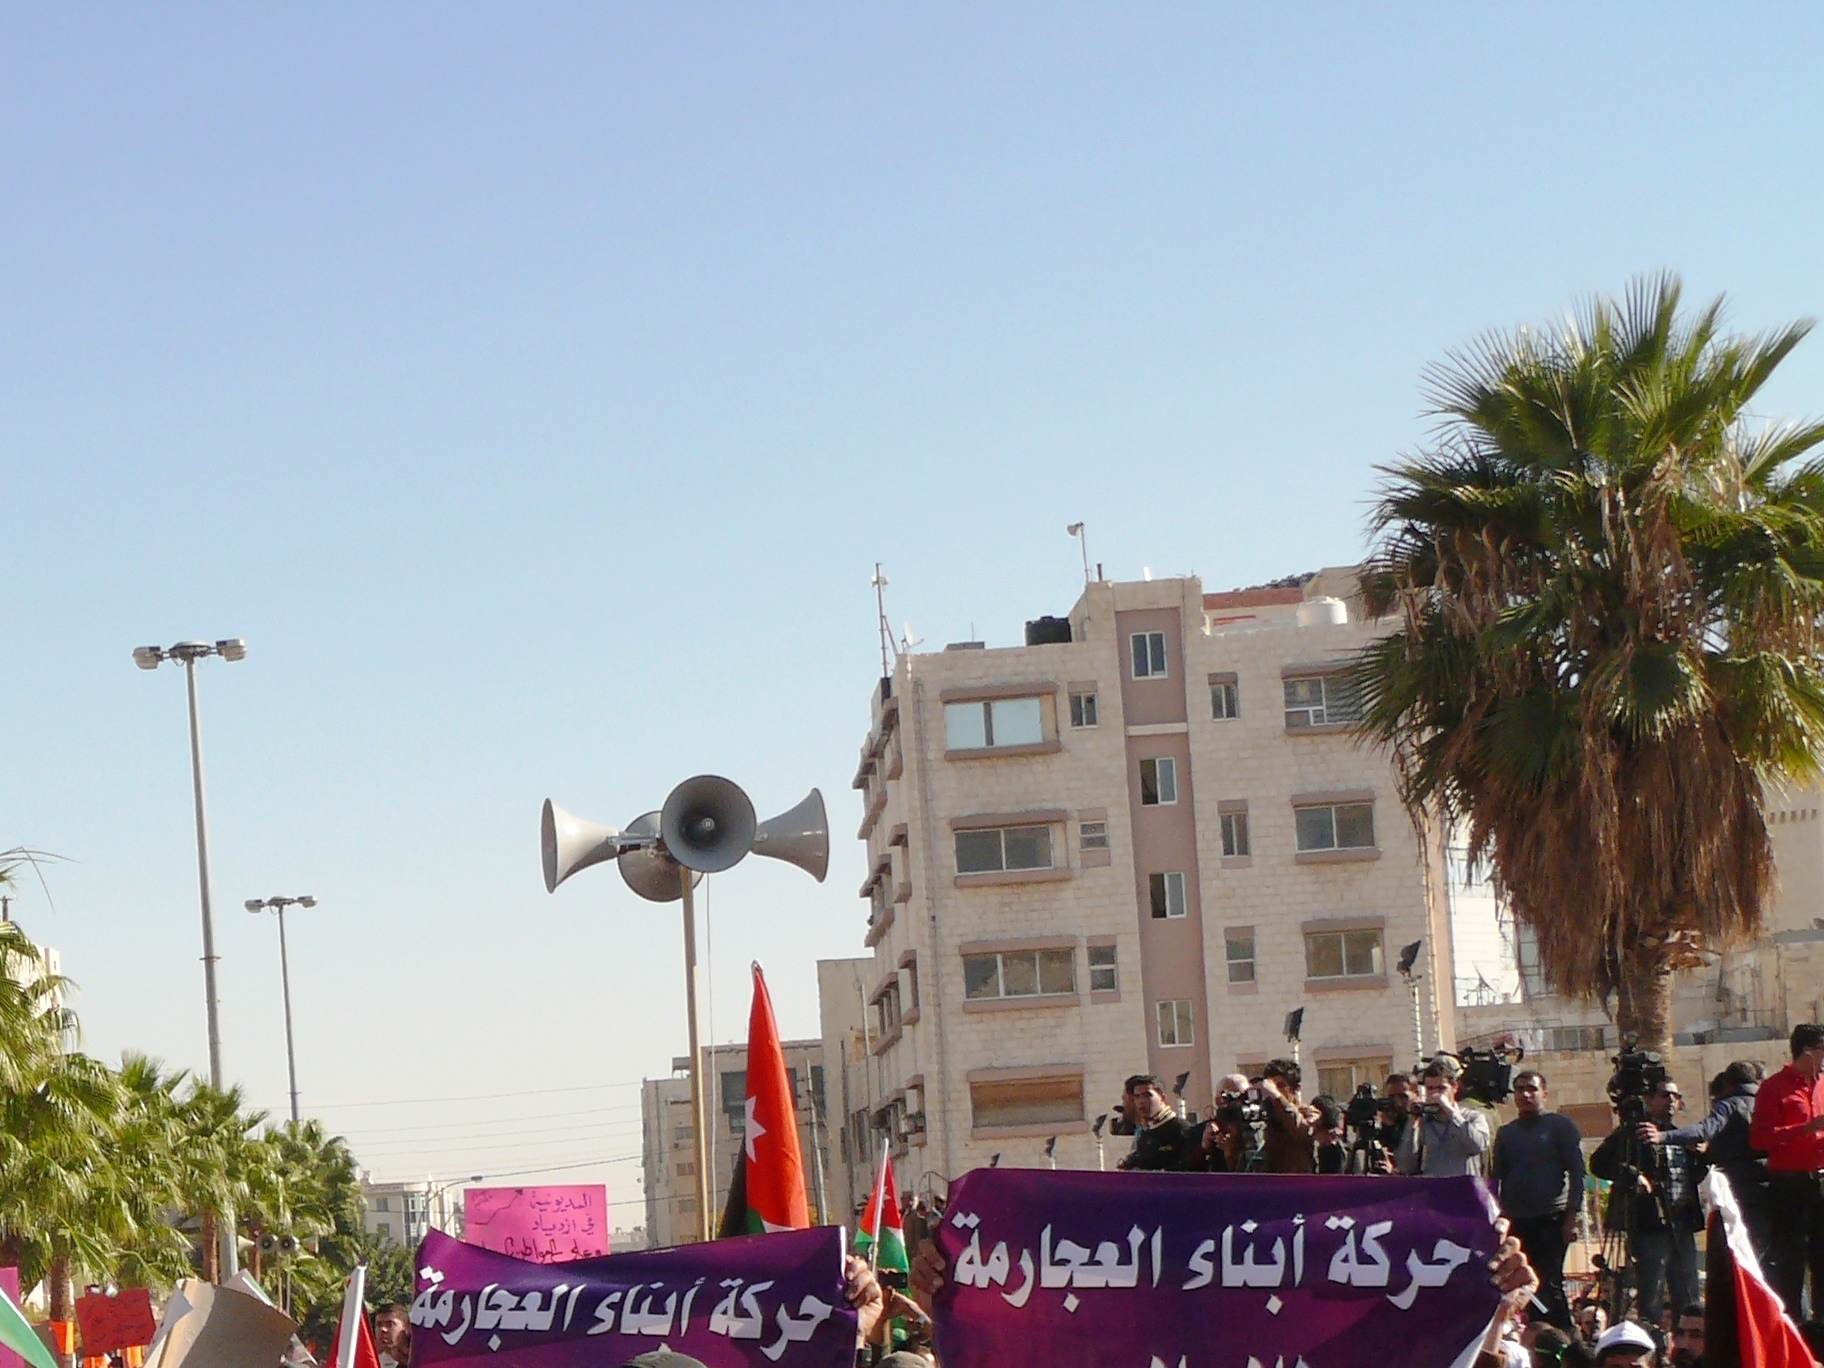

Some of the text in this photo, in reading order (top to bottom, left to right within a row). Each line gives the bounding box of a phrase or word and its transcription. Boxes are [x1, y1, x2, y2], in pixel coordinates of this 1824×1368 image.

[529, 1190, 592, 1213] المديونية
[951, 1211, 1473, 1314] حركة أبناء العجارمة
[407, 1264, 587, 1351] العجارمة
[708, 1278, 833, 1361] حركة
